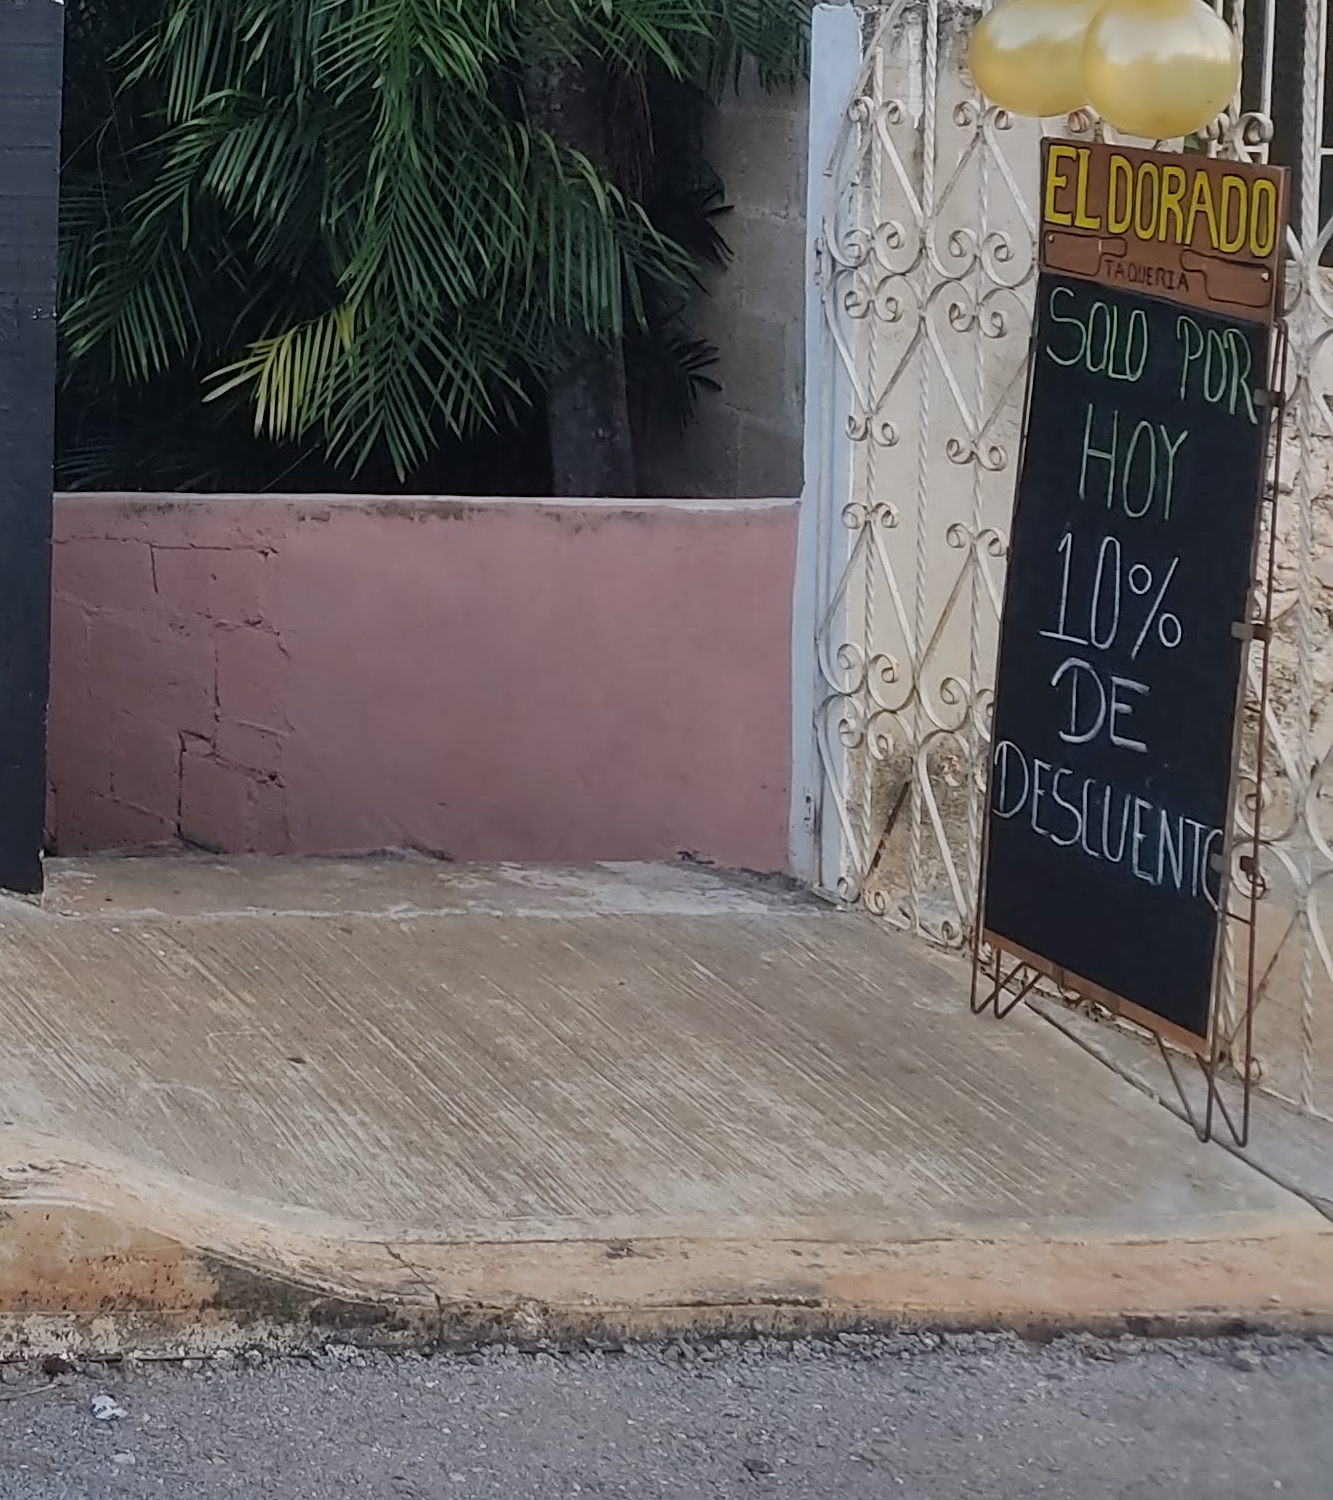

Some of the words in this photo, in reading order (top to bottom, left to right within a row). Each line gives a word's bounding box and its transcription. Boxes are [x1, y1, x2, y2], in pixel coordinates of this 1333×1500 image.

[1044, 145, 1100, 230] EL
[1106, 154, 1277, 257] DORADO
[1105, 259, 1190, 292] TAQUERIA
[1046, 286, 1148, 382] SOLO
[1177, 316, 1259, 423] POR
[1079, 403, 1189, 520] HOY
[1039, 532, 1182, 659] 10%
[1051, 658, 1150, 752] DE
